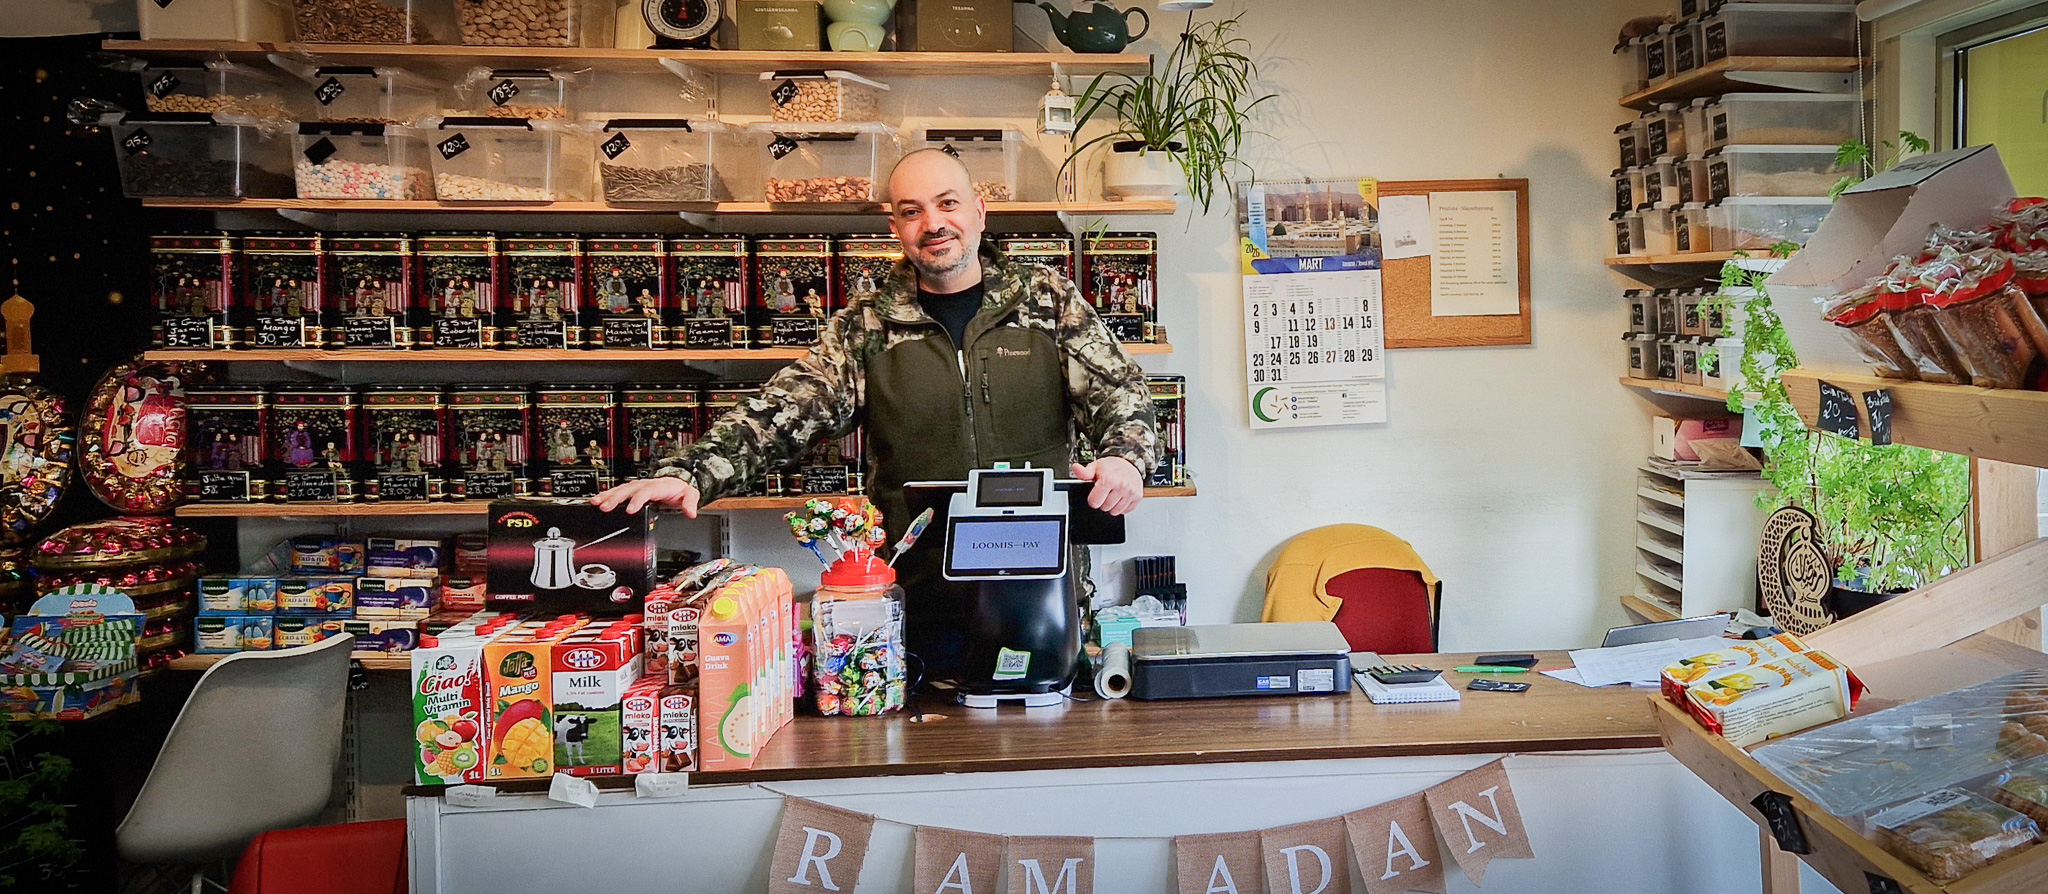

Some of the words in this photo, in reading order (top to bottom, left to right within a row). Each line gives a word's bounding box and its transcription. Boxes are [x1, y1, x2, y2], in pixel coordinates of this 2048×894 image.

[1298, 257, 1325, 271] MART
[1253, 304, 1259, 317] 2
[1271, 303, 1278, 317] 3
[1289, 302, 1296, 315] 4
[1308, 301, 1314, 315] 5
[1362, 299, 1369, 312] 8
[435, 319, 449, 327] Te
[450, 318, 478, 326] Svart
[1254, 320, 1260, 334] 9
[1288, 318, 1299, 332] 11
[1305, 318, 1316, 331] 12
[1324, 317, 1336, 331] 13
[1342, 316, 1354, 330] 14
[1360, 315, 1372, 329] 15
[170, 325, 205, 335] Jasmin
[263, 325, 296, 335] Mango
[1270, 336, 1282, 349] 17
[1289, 335, 1300, 349] 18
[1306, 334, 1318, 348] 19
[1253, 353, 1264, 367] 23
[1270, 352, 1282, 366] 24
[1289, 351, 1301, 365] 25
[1307, 351, 1319, 364] 26
[1325, 350, 1337, 364] 27
[1344, 349, 1355, 363] 28
[1361, 348, 1373, 362] 29
[1253, 368, 1265, 382] 30
[1271, 368, 1282, 381] 31
[466, 487, 498, 495] 28,00
[506, 518, 534, 528] PSD
[503, 652, 533, 676] Jaffa
[705, 662, 729, 671] Drink
[420, 670, 473, 694] Ciao!
[569, 675, 602, 688] Milk
[499, 682, 541, 697] Mango
[427, 691, 459, 706] Multi
[423, 699, 472, 715] Vitamin
[468, 771, 481, 780] 1L
[490, 767, 502, 777] 1L
[596, 766, 617, 774] LITER
